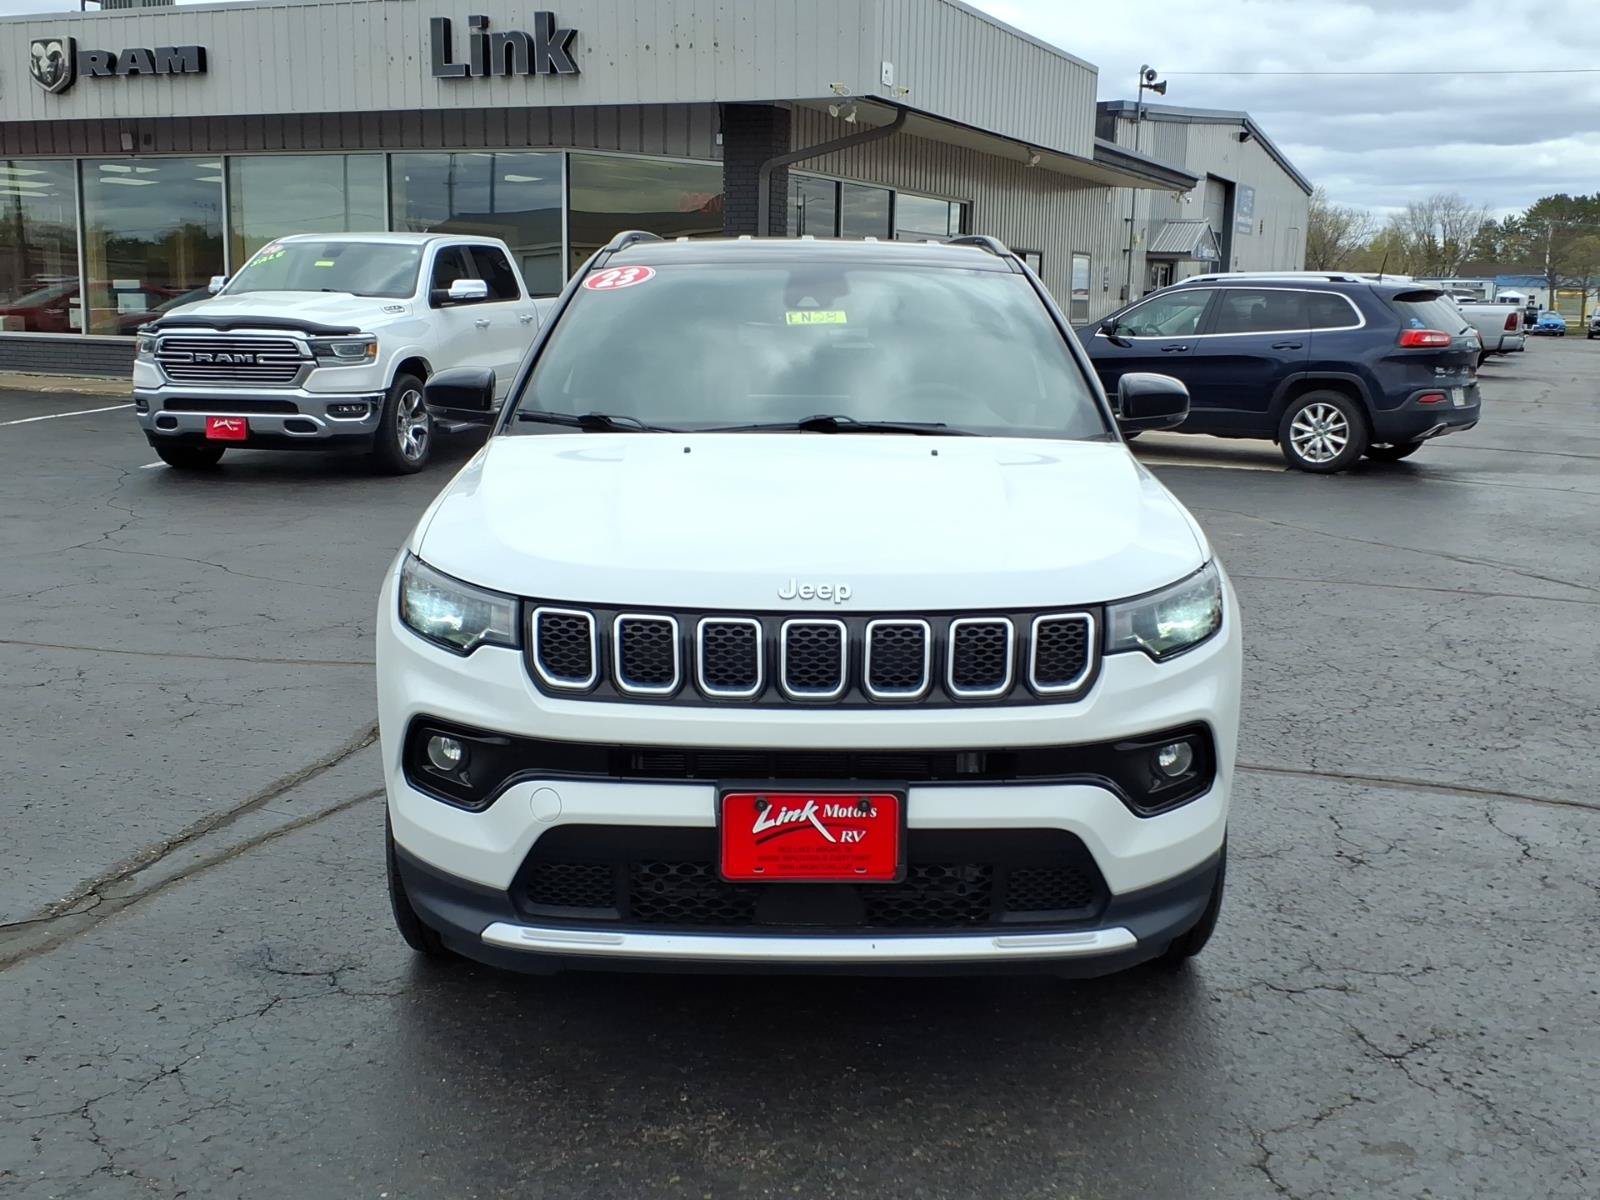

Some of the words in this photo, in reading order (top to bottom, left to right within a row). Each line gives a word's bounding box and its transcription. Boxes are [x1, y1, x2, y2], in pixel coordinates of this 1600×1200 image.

[430, 11, 580, 77] Link
[79, 45, 207, 77] RAM
[595, 268, 640, 289] 23
[194, 353, 254, 363] RAM
[778, 577, 852, 604] Jeep
[752, 800, 837, 843] Link
[840, 830, 866, 843] RV
